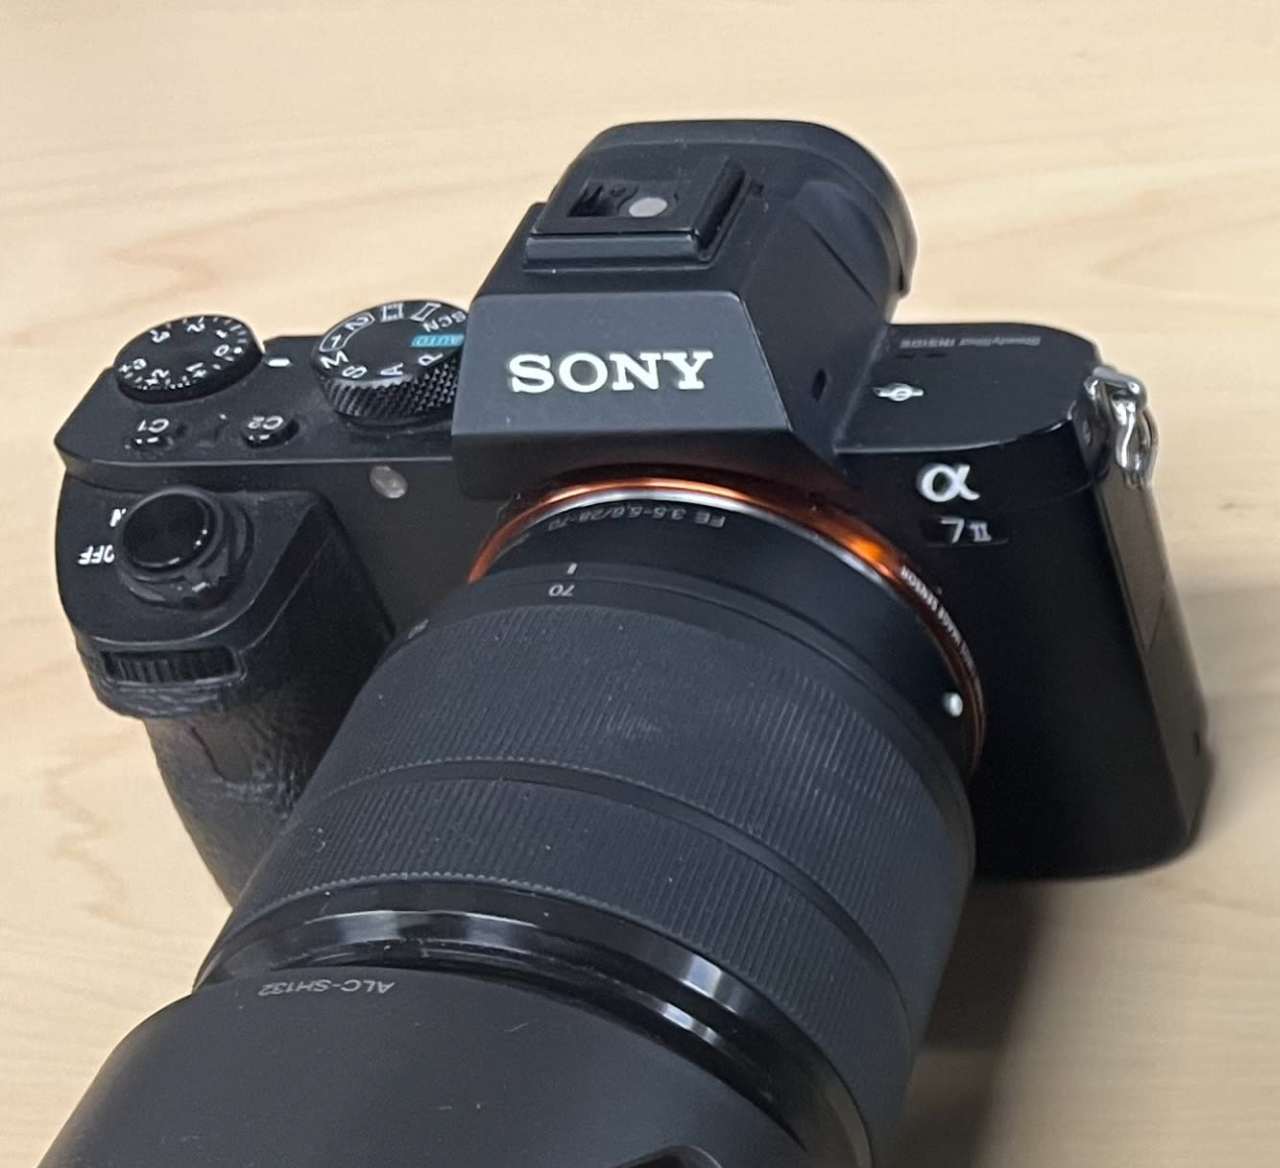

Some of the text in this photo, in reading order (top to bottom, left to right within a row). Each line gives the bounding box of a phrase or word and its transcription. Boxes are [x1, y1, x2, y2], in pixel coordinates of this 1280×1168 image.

[423, 311, 467, 333] SCN
[320, 351, 349, 369] M
[418, 353, 444, 366] P
[342, 365, 368, 379] S
[380, 362, 404, 376] A
[508, 350, 713, 394] SONY
[137, 418, 169, 433] C1
[247, 415, 283, 430] C2
[694, 511, 727, 528] FE
[77, 544, 115, 565] OFF
[548, 584, 575, 597] 70
[257, 978, 396, 997] ALC-SH132
